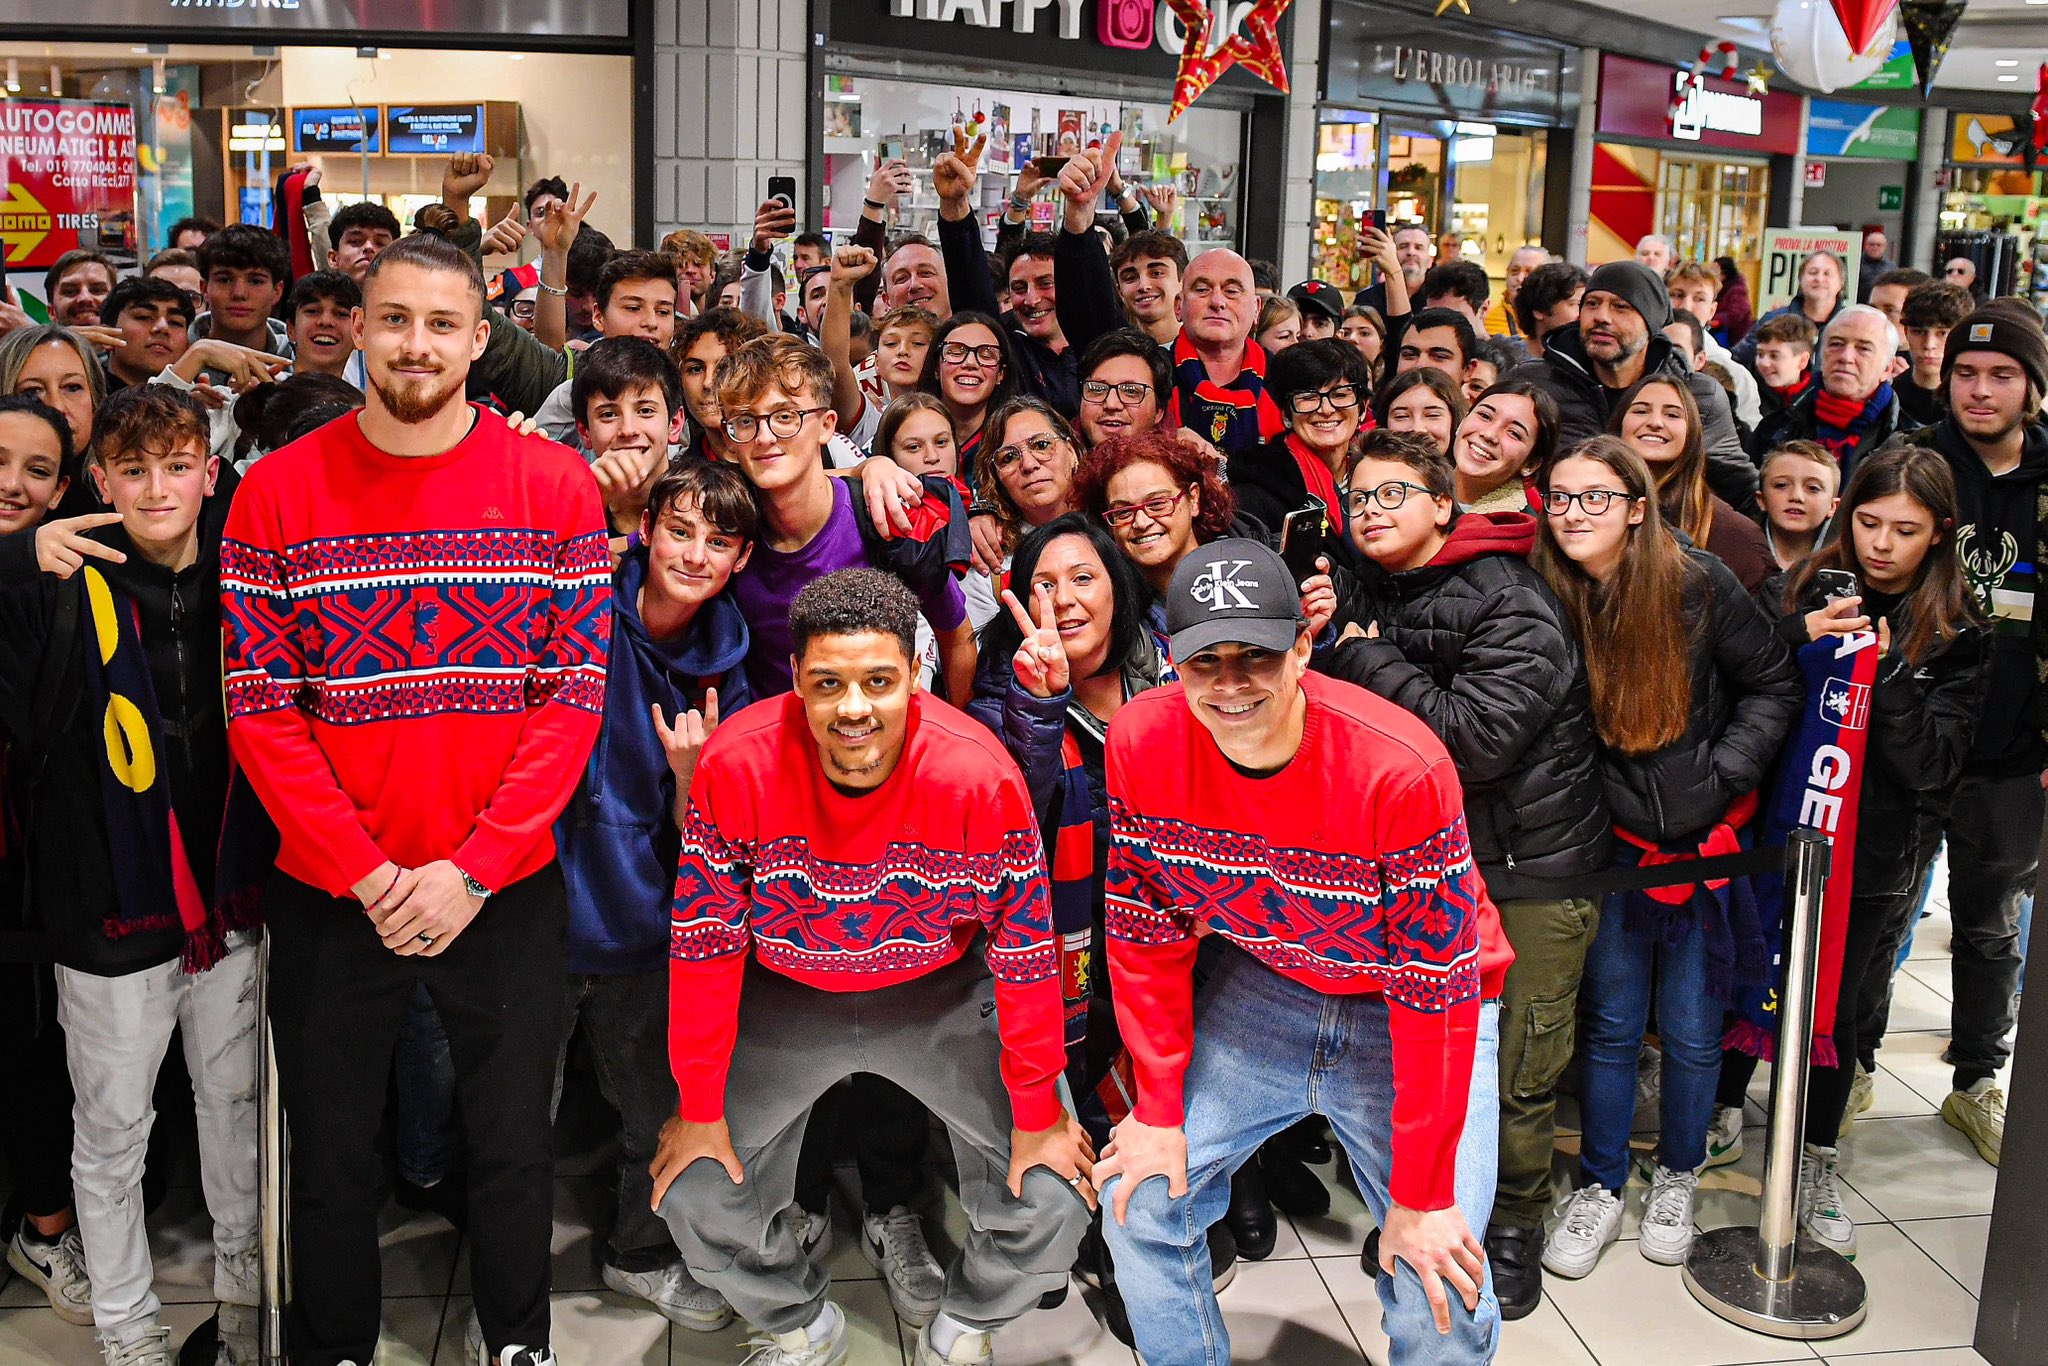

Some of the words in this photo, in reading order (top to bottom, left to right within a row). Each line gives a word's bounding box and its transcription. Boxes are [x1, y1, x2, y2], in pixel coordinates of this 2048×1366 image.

[1394, 46, 1535, 95] L'ERBOLARIO
[21, 159, 43, 173] Tel.
[46, 160, 70, 173] 019
[0, 215, 51, 230] omo
[57, 213, 99, 230] TIRES
